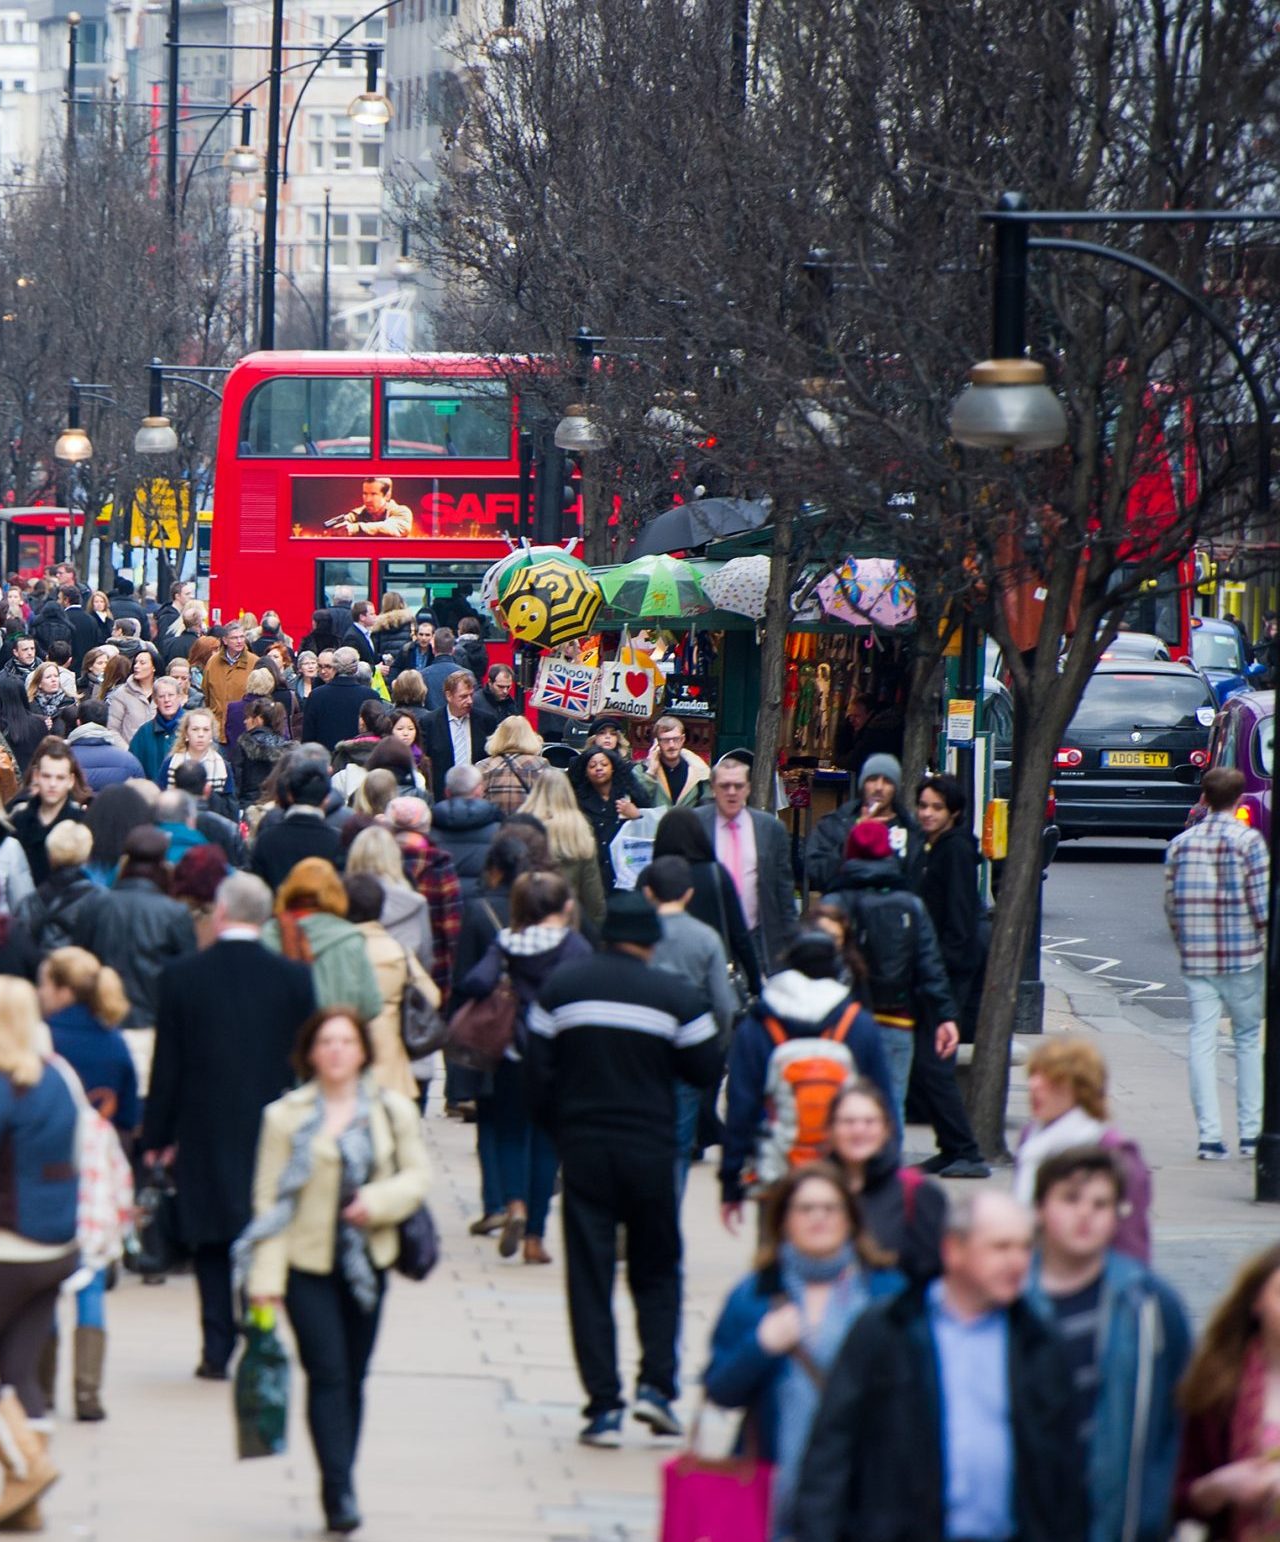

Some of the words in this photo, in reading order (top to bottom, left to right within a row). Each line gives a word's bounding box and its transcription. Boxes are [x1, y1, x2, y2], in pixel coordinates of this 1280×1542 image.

[549, 663, 593, 681] LONDON
[610, 672, 620, 693] I
[603, 697, 649, 717] London
[671, 698, 710, 710] London
[1143, 754, 1166, 764] ETY
